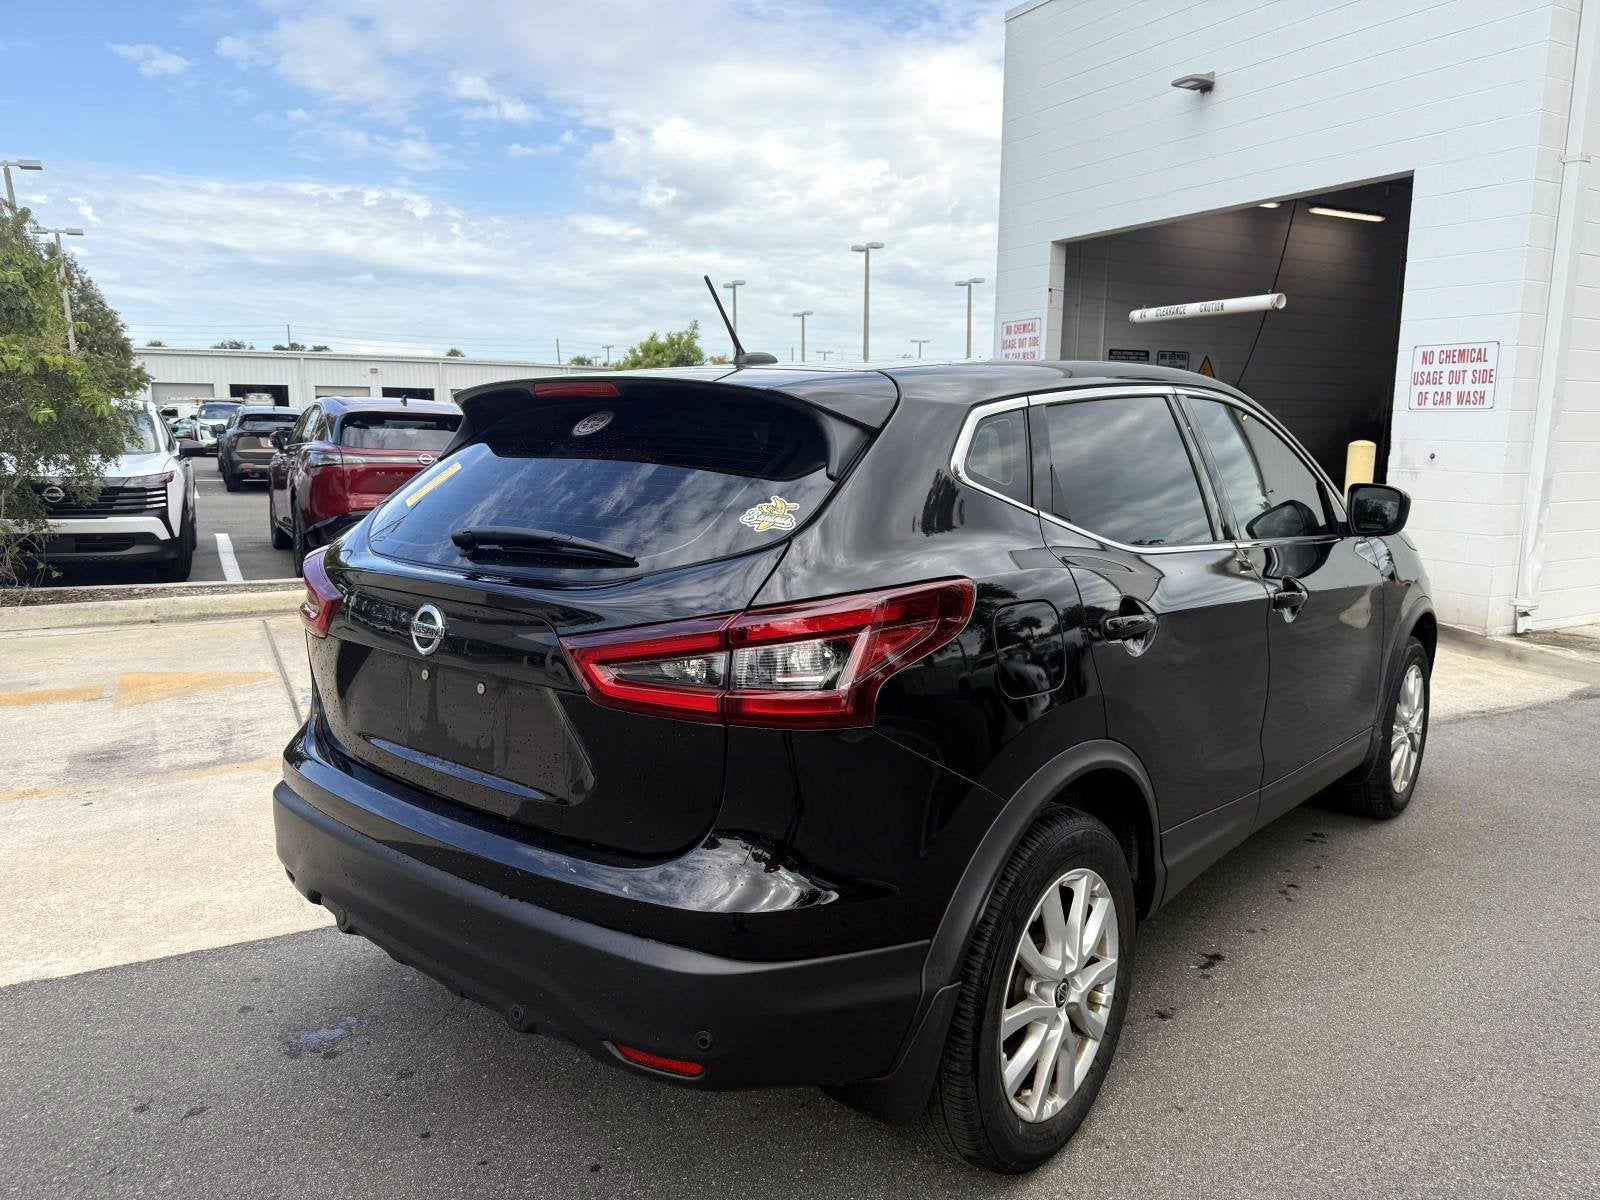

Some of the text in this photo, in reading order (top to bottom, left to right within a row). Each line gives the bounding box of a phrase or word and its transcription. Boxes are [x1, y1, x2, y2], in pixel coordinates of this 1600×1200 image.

[1155, 305, 1187, 318] CLEARANCE
[1199, 301, 1225, 313] CAUTION
[1421, 347, 1488, 365] NO CHEMICAL
[1413, 368, 1494, 386] USAGE OUT SIDE
[1417, 390, 1486, 406] OF CAR WASH
[412, 622, 444, 638] NISSAN
